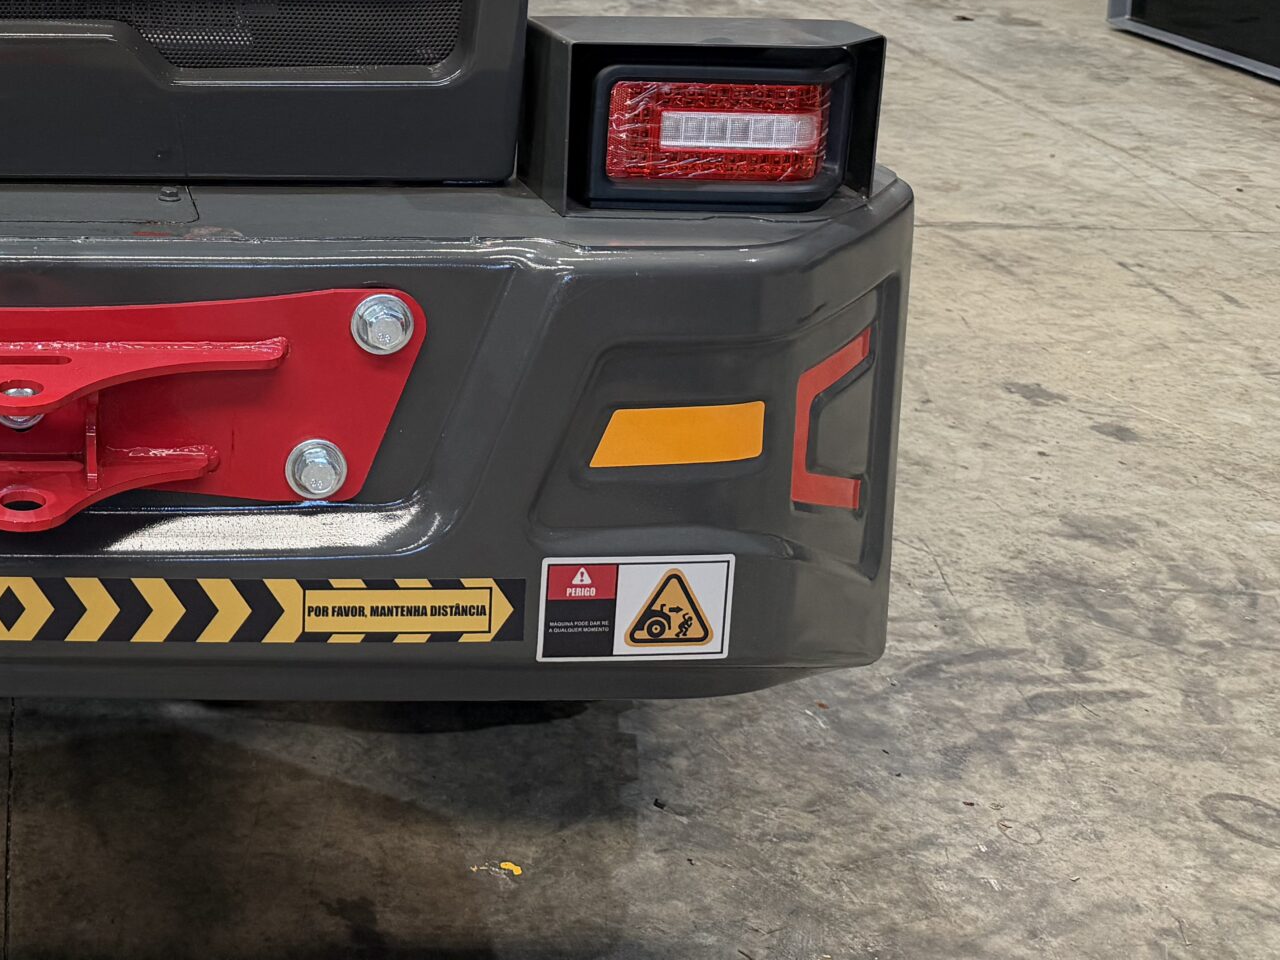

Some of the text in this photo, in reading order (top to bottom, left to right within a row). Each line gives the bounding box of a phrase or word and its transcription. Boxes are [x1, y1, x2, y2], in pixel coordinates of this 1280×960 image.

[566, 587, 596, 597] PERIGO
[307, 602, 487, 619] POR FAVOR, MANTENHA DISTÂNCIA
